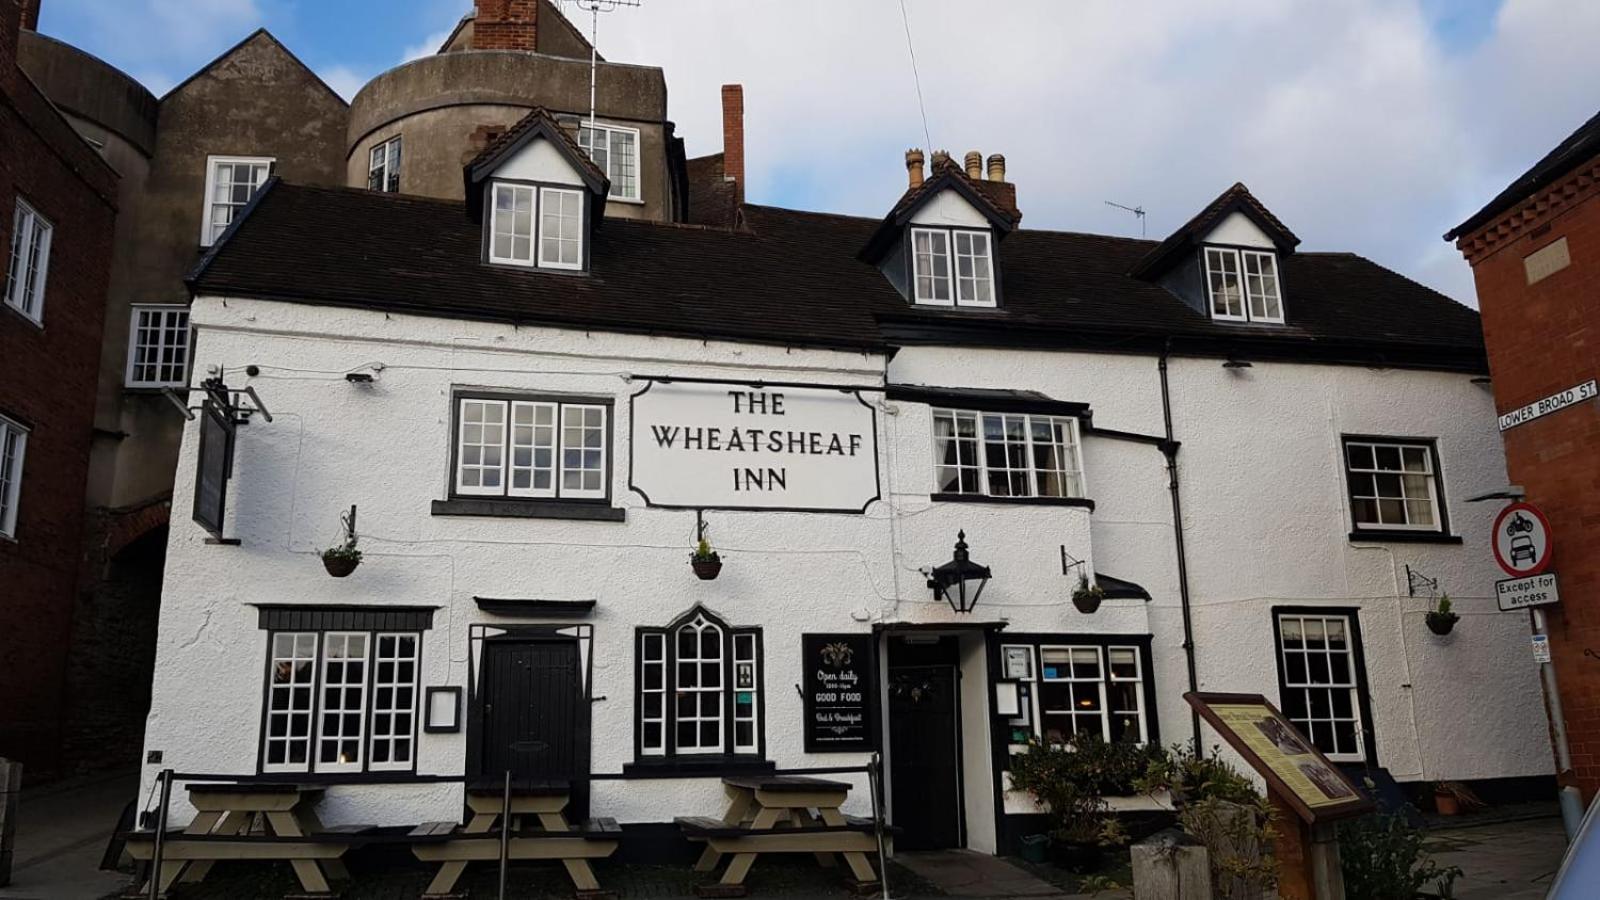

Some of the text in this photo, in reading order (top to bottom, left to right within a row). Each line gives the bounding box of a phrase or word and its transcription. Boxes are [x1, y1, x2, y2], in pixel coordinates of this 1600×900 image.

[728, 390, 785, 415] THE
[1501, 406, 1534, 428] LOWER
[1538, 391, 1574, 413] BROAD
[651, 425, 862, 456] WHEATSHEAF
[733, 467, 787, 491] INN
[1499, 577, 1554, 594] Except for
[1511, 592, 1548, 605] access
[817, 669, 858, 685] Open daily
[816, 692, 861, 702] GOOD FOOD
